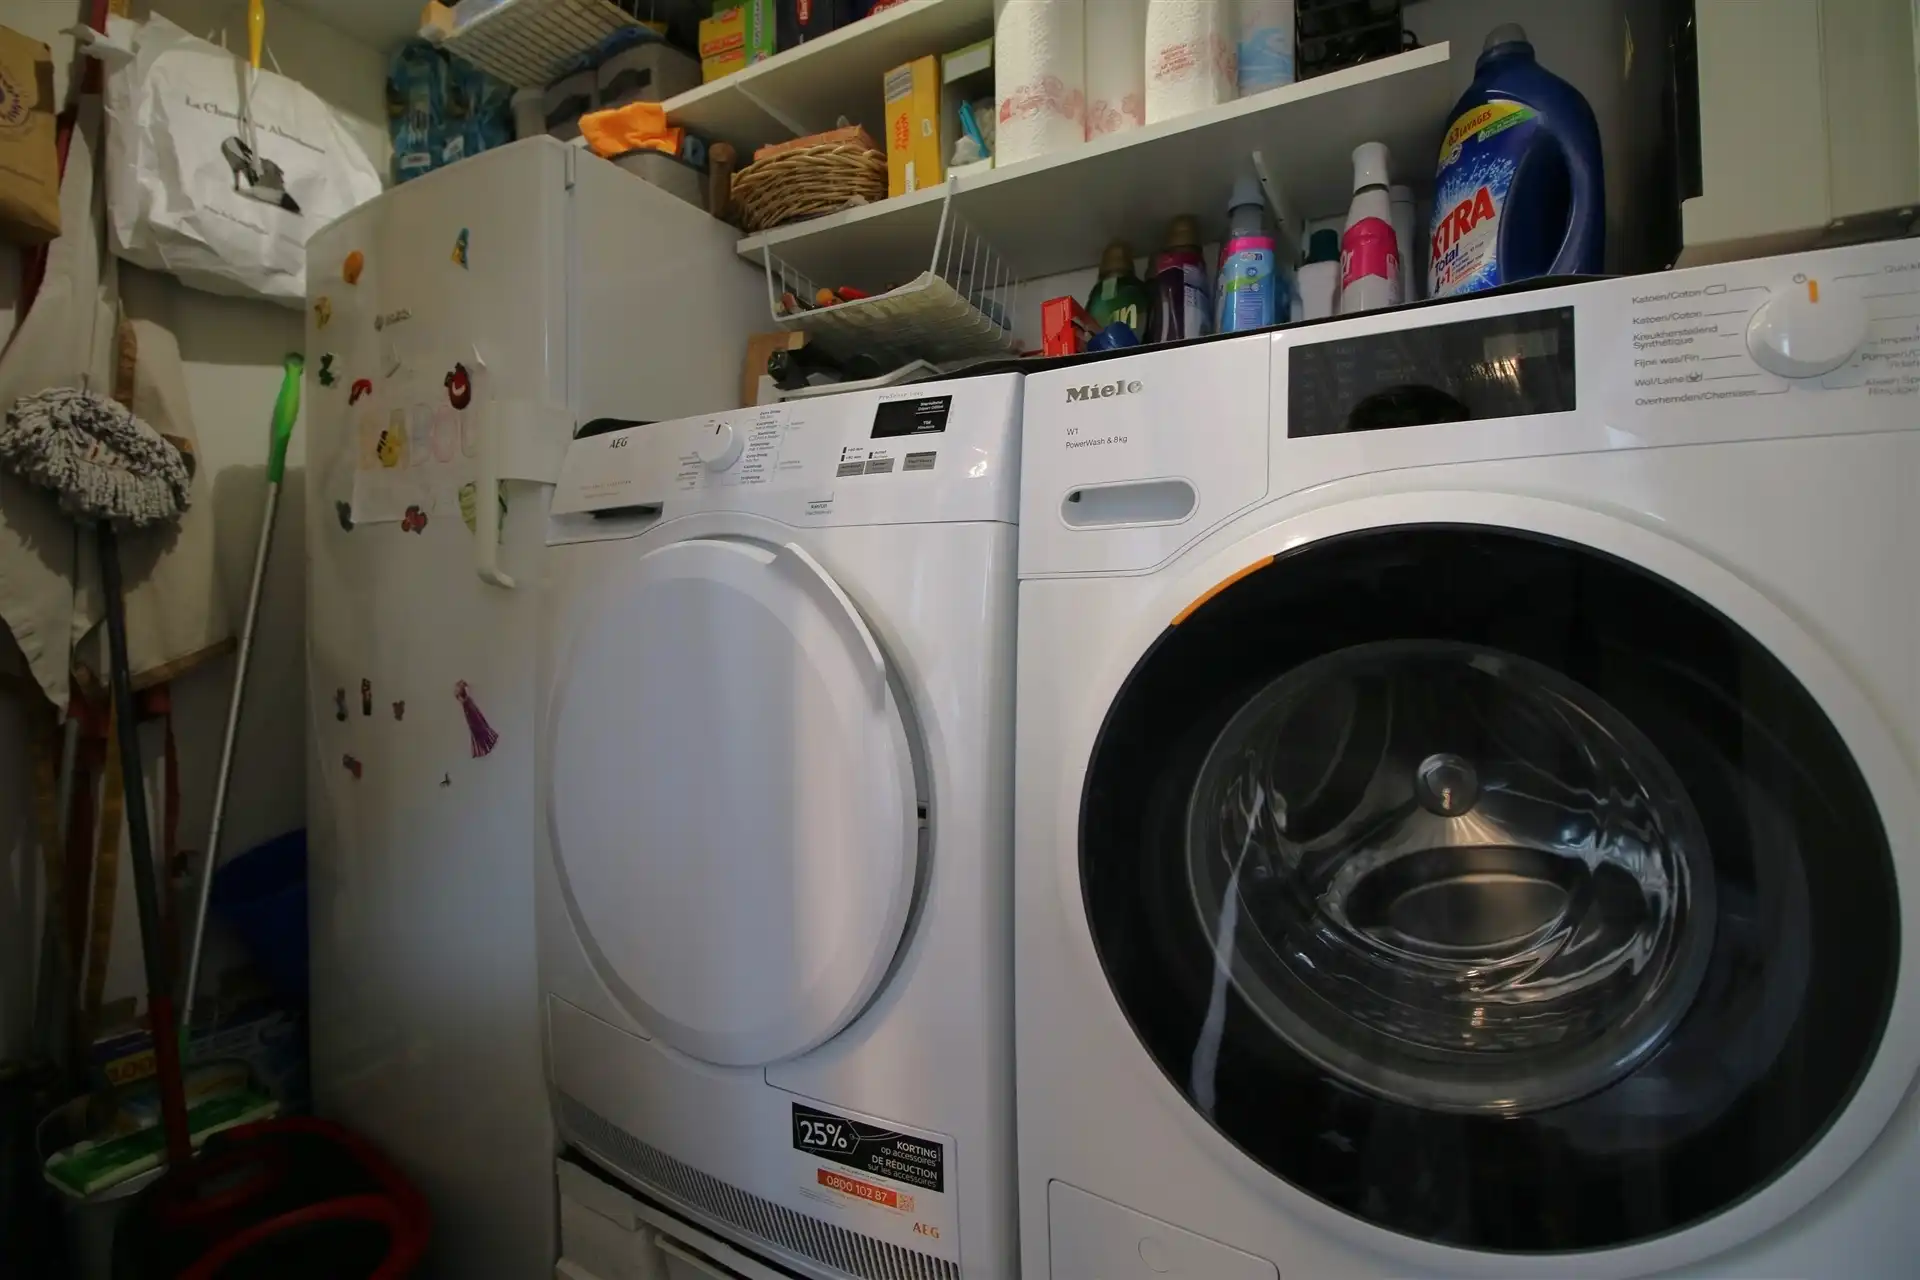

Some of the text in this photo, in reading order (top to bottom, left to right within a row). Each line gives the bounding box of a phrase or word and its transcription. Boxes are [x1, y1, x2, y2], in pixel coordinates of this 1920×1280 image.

[1459, 109, 1493, 136] LAVAGES
[1066, 380, 1144, 403] Miele
[1066, 428, 1079, 436] W1
[609, 437, 628, 449] AEG
[1065, 438, 1105, 451] PowerWash
[1106, 436, 1112, 444] &
[799, 1120, 848, 1149] 25%
[880, 1146, 891, 1156] op
[896, 1141, 937, 1159] KORTING
[867, 1163, 879, 1172] sur
[880, 1164, 892, 1175] les
[893, 1168, 937, 1188] accessoires
[871, 1154, 884, 1165] DE
[885, 1157, 937, 1180] RÉDUCTION
[826, 1175, 853, 1192] 0800
[855, 1184, 873, 1199] 102
[874, 1190, 888, 1202] 87
[912, 1221, 940, 1239] AEG
